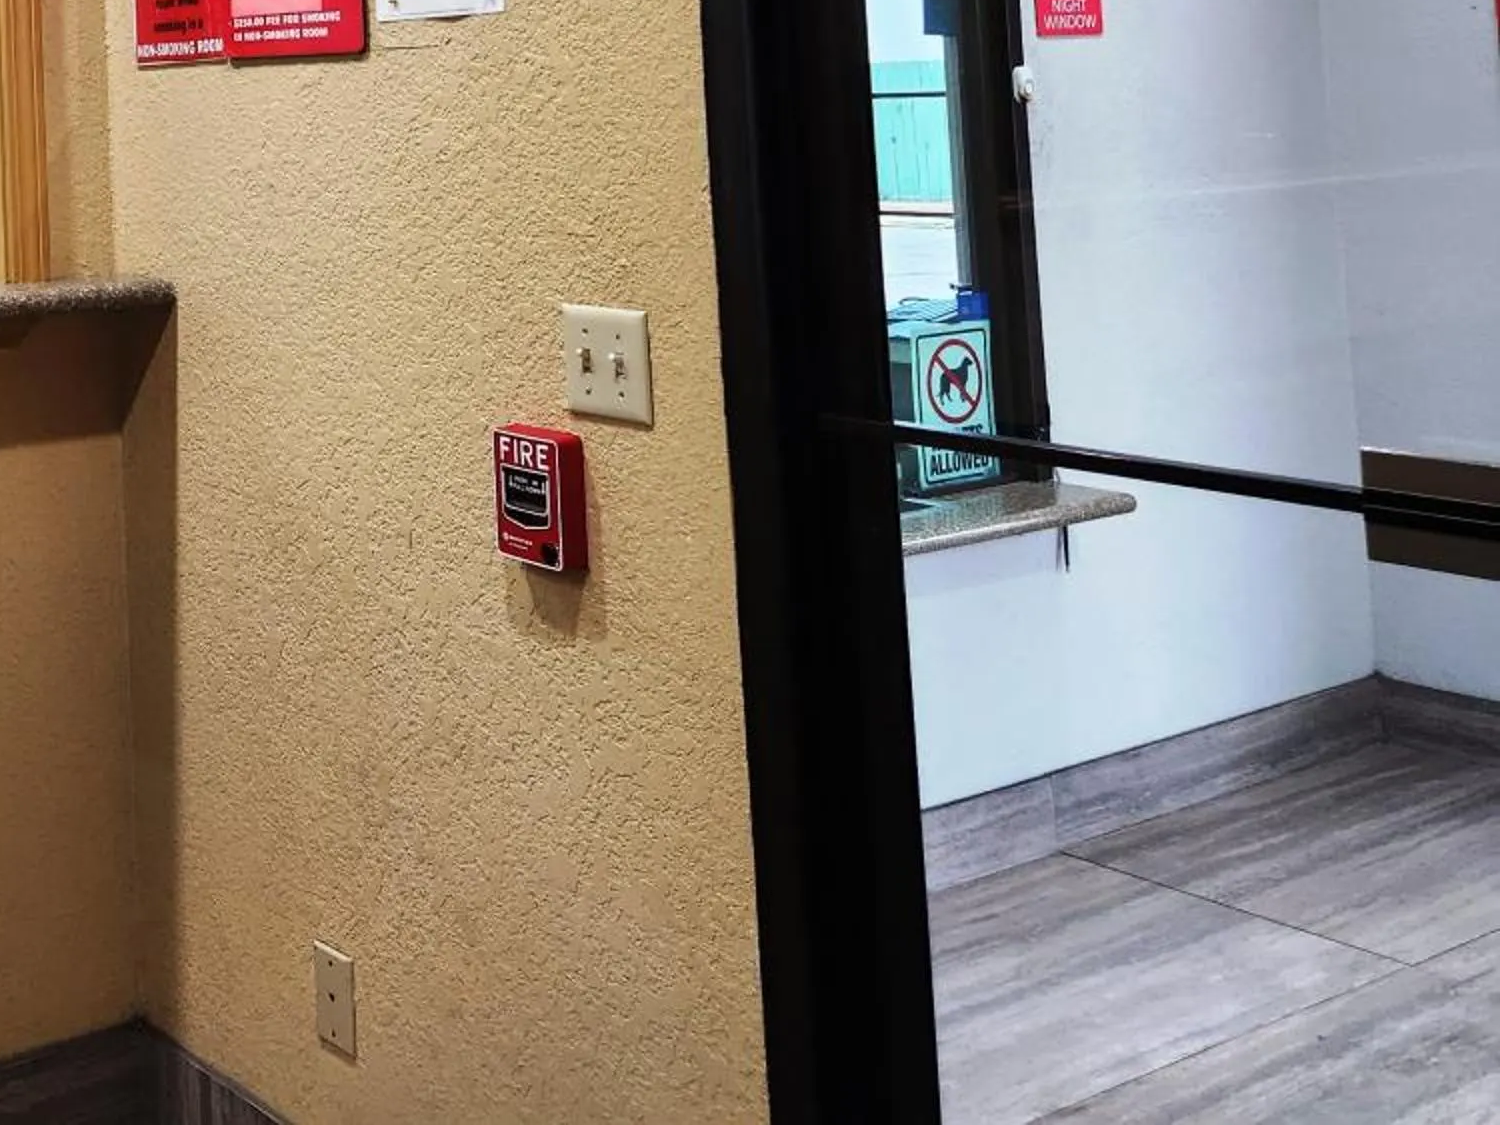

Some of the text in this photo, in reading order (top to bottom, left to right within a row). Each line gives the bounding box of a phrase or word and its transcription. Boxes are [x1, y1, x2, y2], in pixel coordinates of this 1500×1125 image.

[1044, 14, 1096, 30] WINDOW
[302, 27, 328, 38] ROOM
[197, 37, 223, 53] ROOM
[500, 436, 549, 470] FIRE
